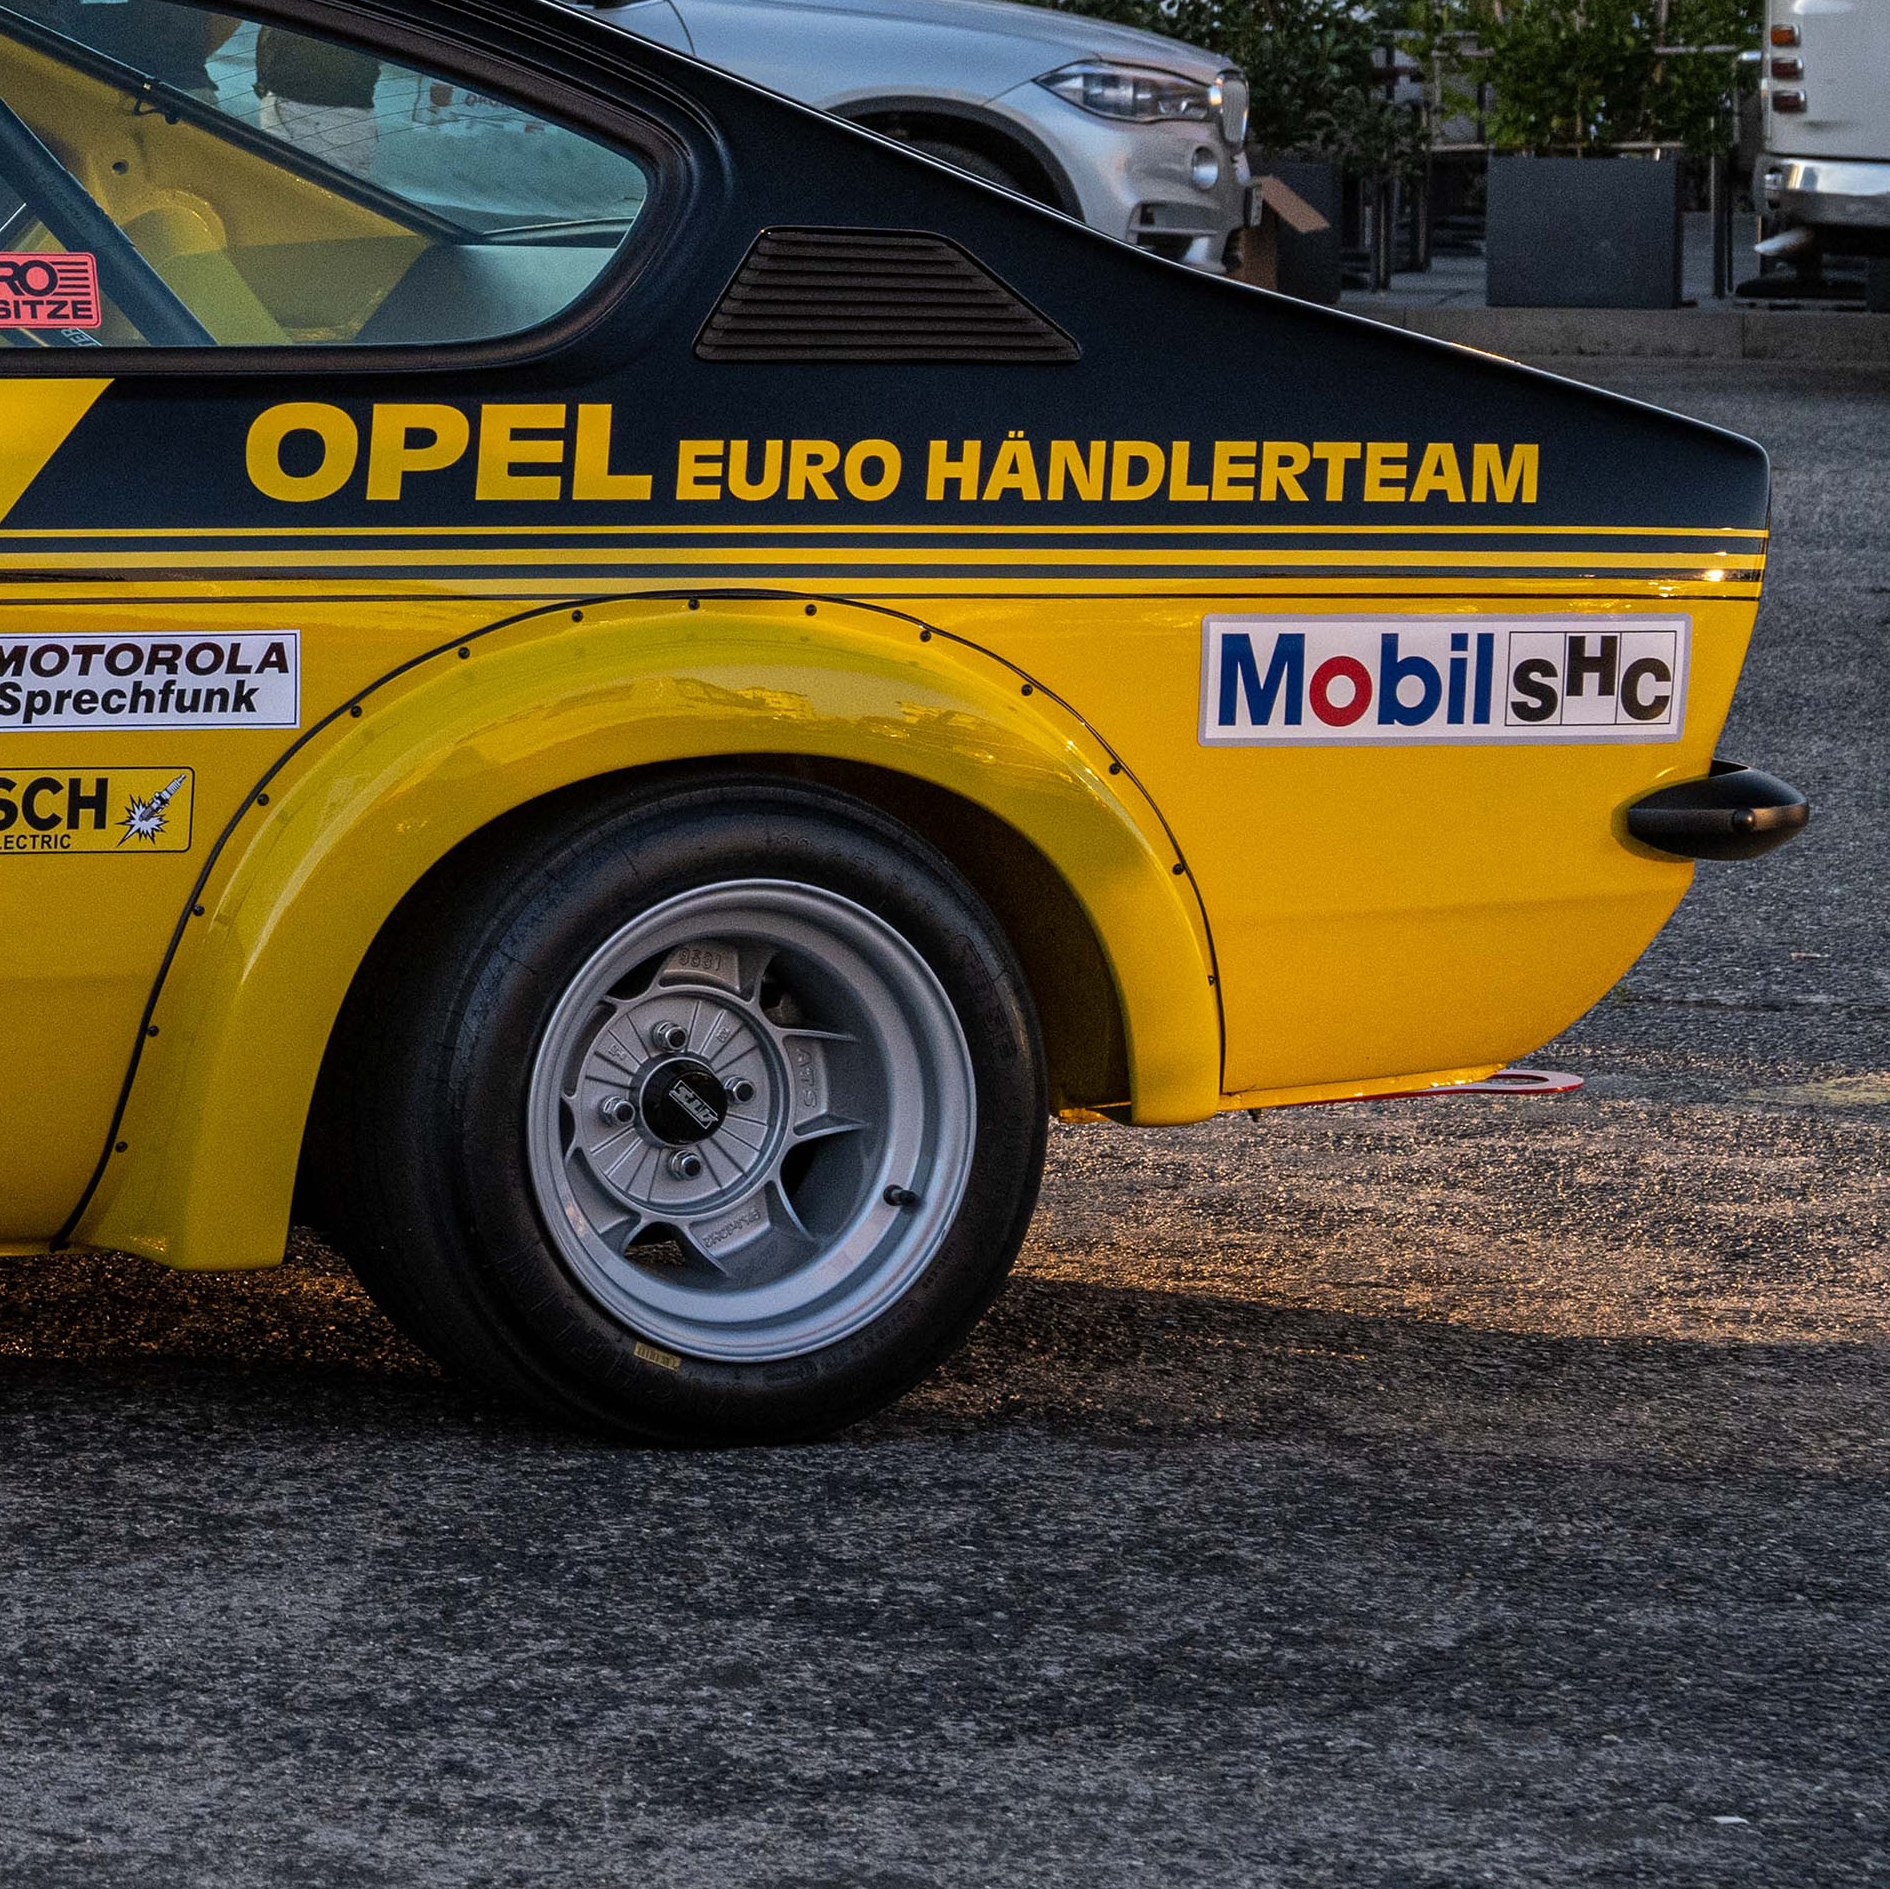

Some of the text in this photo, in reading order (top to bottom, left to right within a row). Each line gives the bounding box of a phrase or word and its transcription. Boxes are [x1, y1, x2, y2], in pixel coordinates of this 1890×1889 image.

[245, 401, 1539, 503] OPEL EURO HÄNDLERTEAM
[1218, 632, 1495, 728] Mobil
